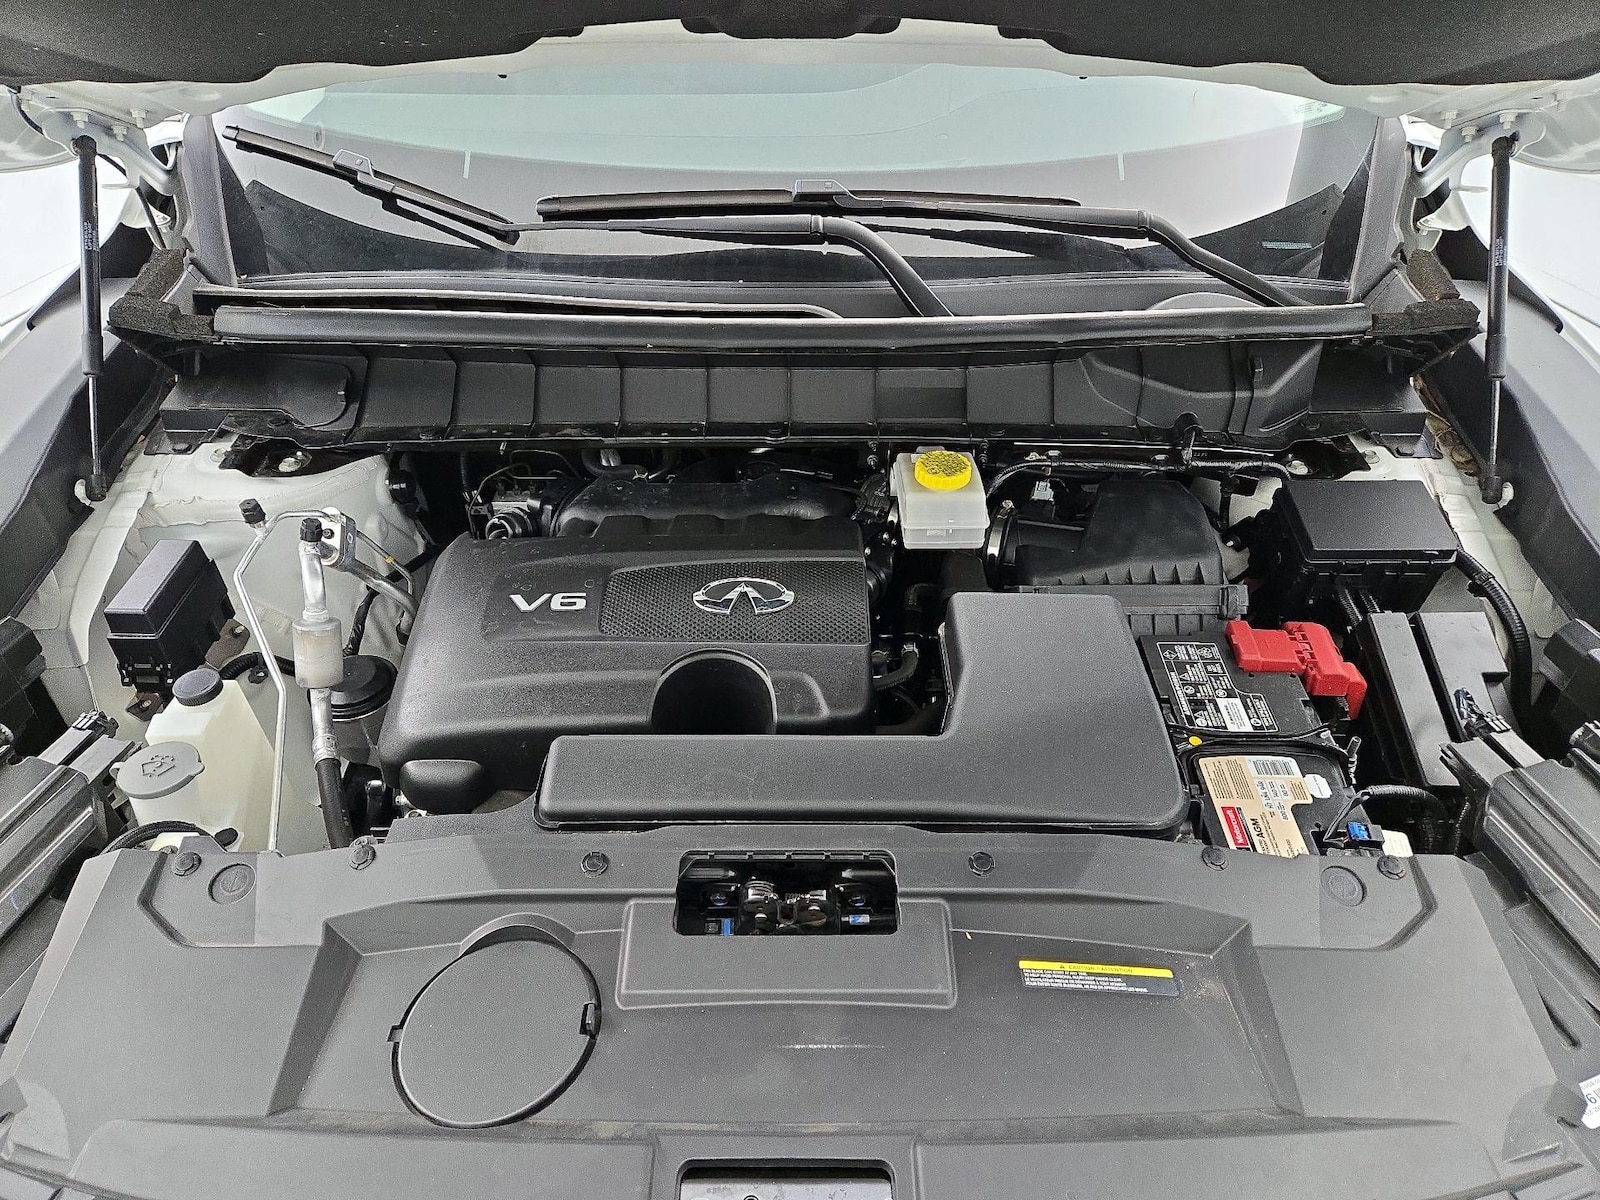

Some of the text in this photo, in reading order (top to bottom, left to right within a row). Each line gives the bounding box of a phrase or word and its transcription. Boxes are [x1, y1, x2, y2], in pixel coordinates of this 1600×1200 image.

[510, 592, 587, 612] V6
[1226, 808, 1245, 844] Motorcraft
[1250, 818, 1265, 839] AGM
